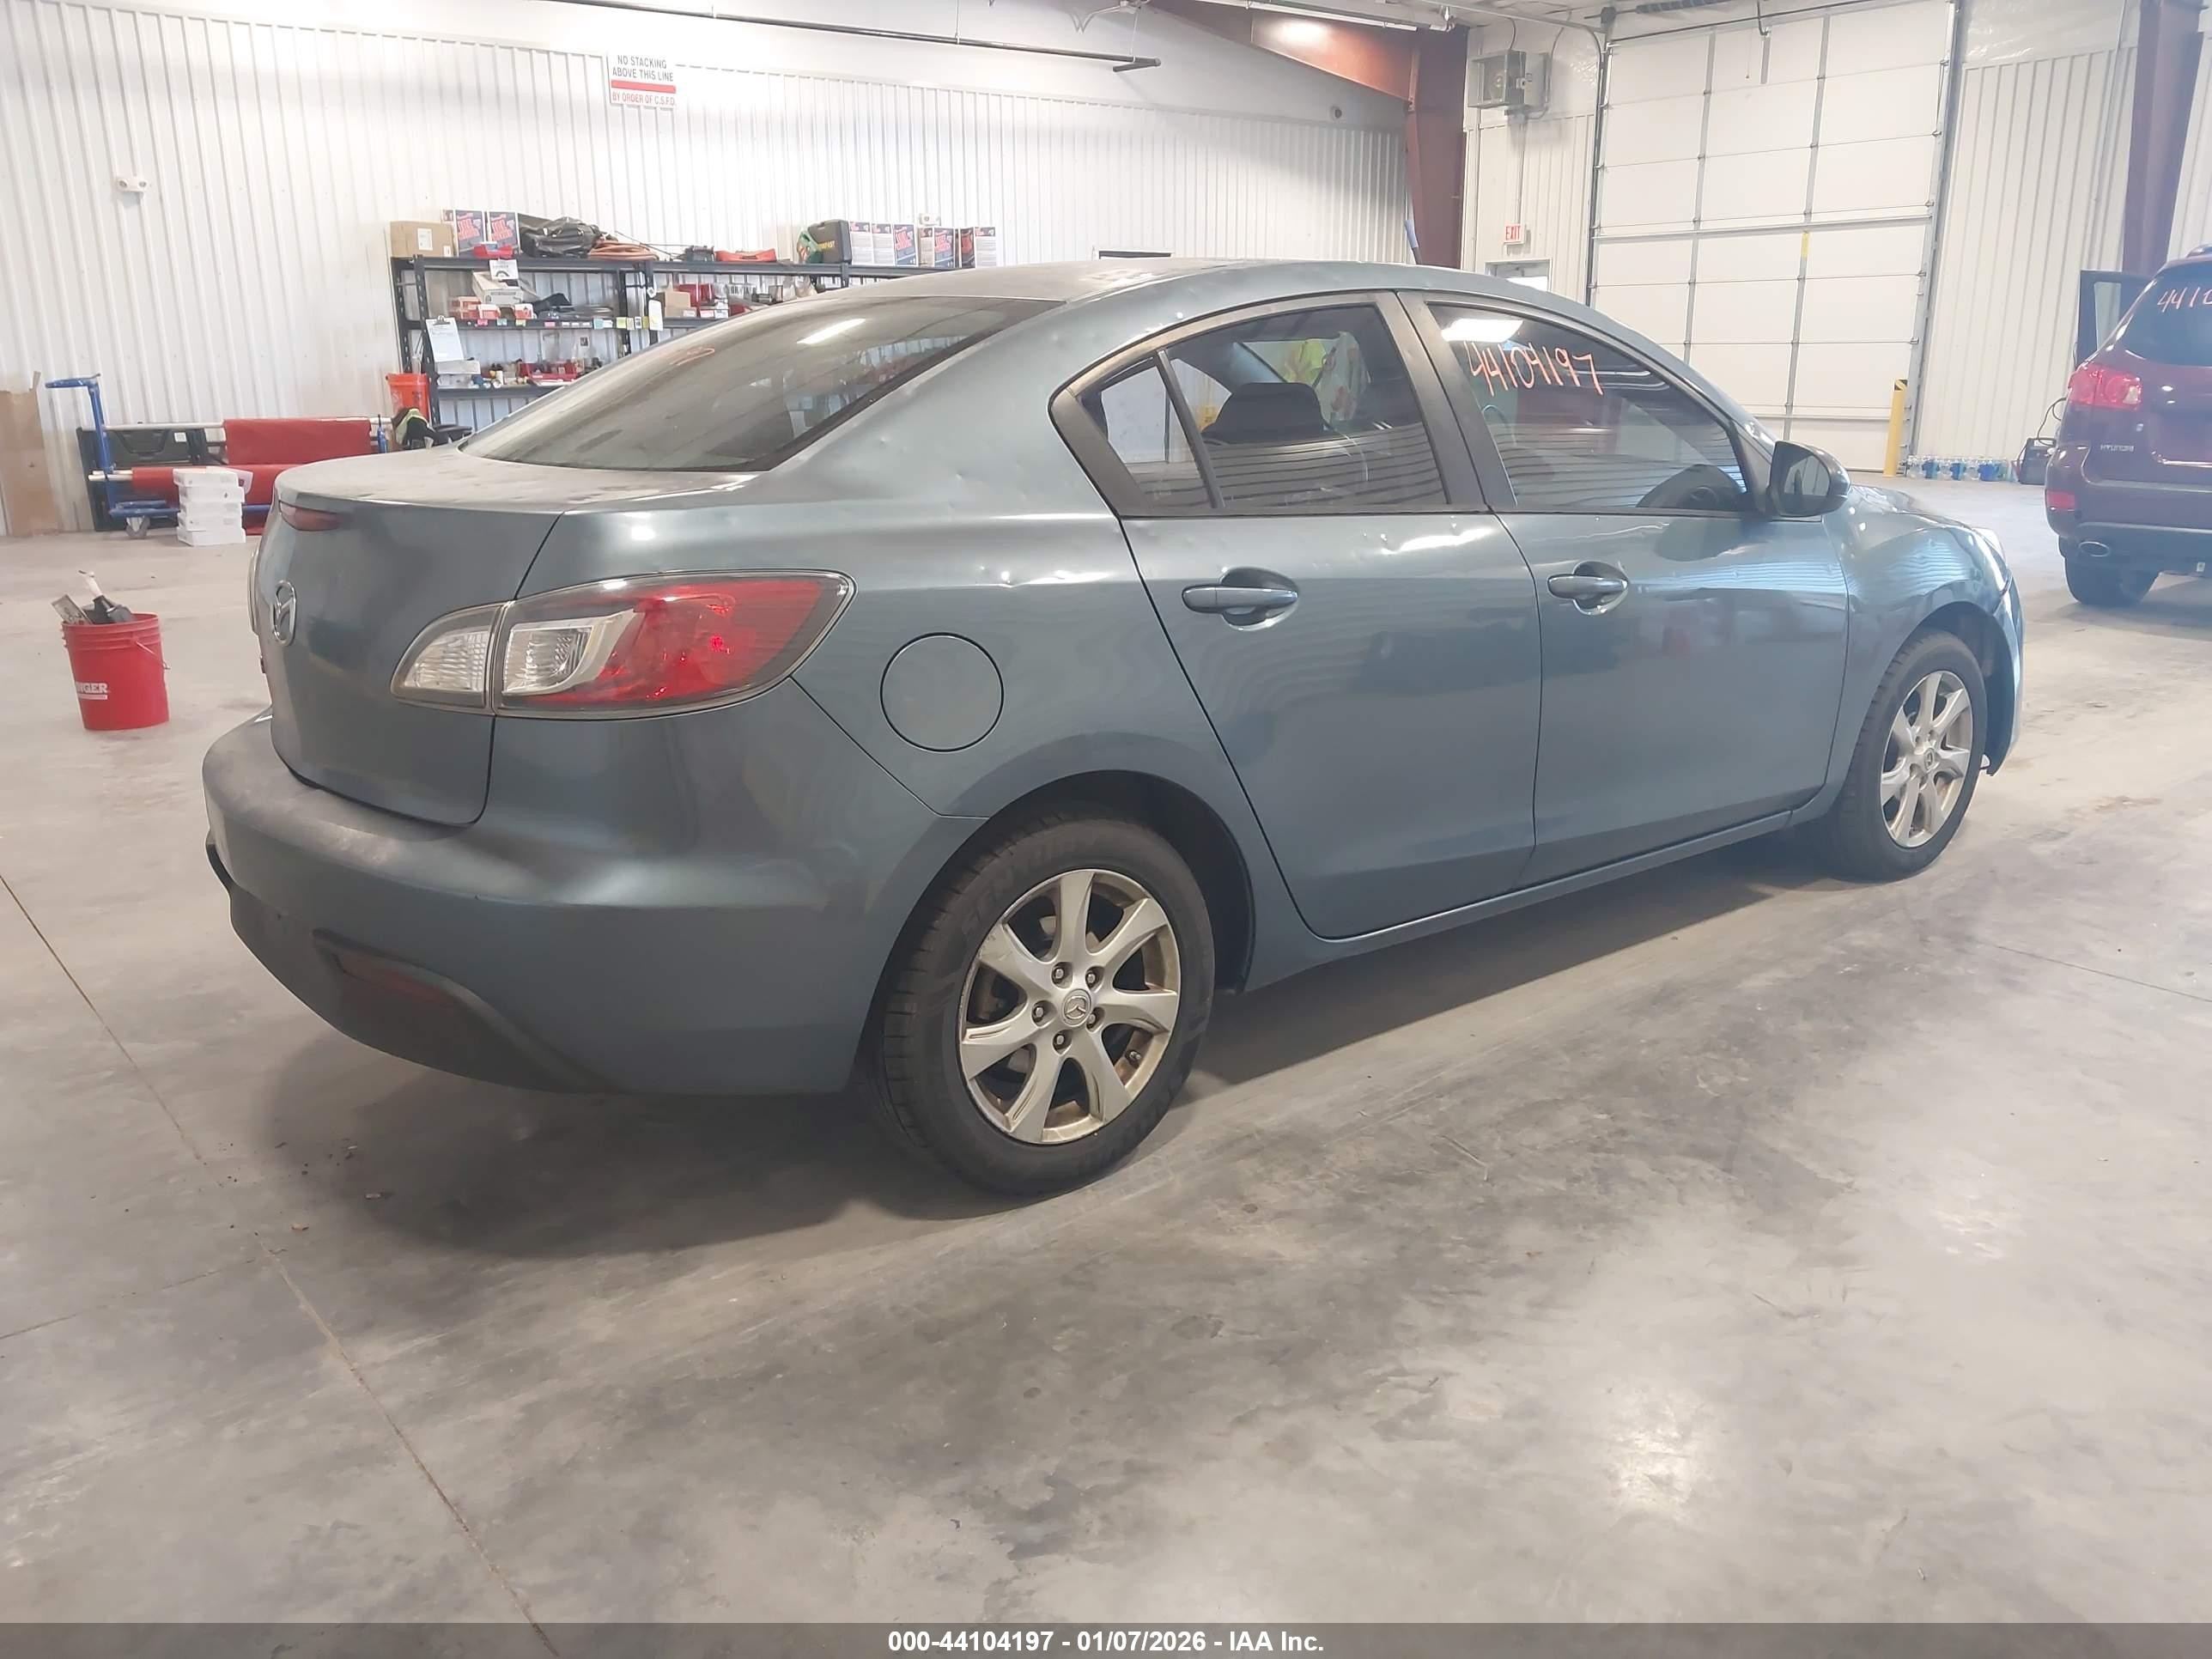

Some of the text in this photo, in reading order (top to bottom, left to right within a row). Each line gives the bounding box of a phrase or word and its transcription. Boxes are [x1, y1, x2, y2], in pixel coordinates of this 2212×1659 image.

[617, 55, 666, 69] NO STACKING
[612, 67, 673, 81] ABOVE THIS LINE
[612, 91, 620, 100] BY
[622, 92, 643, 103] ORDER
[645, 94, 653, 103] OF
[1505, 226, 1520, 240] EXIT
[1463, 341, 1604, 397] 44104197
